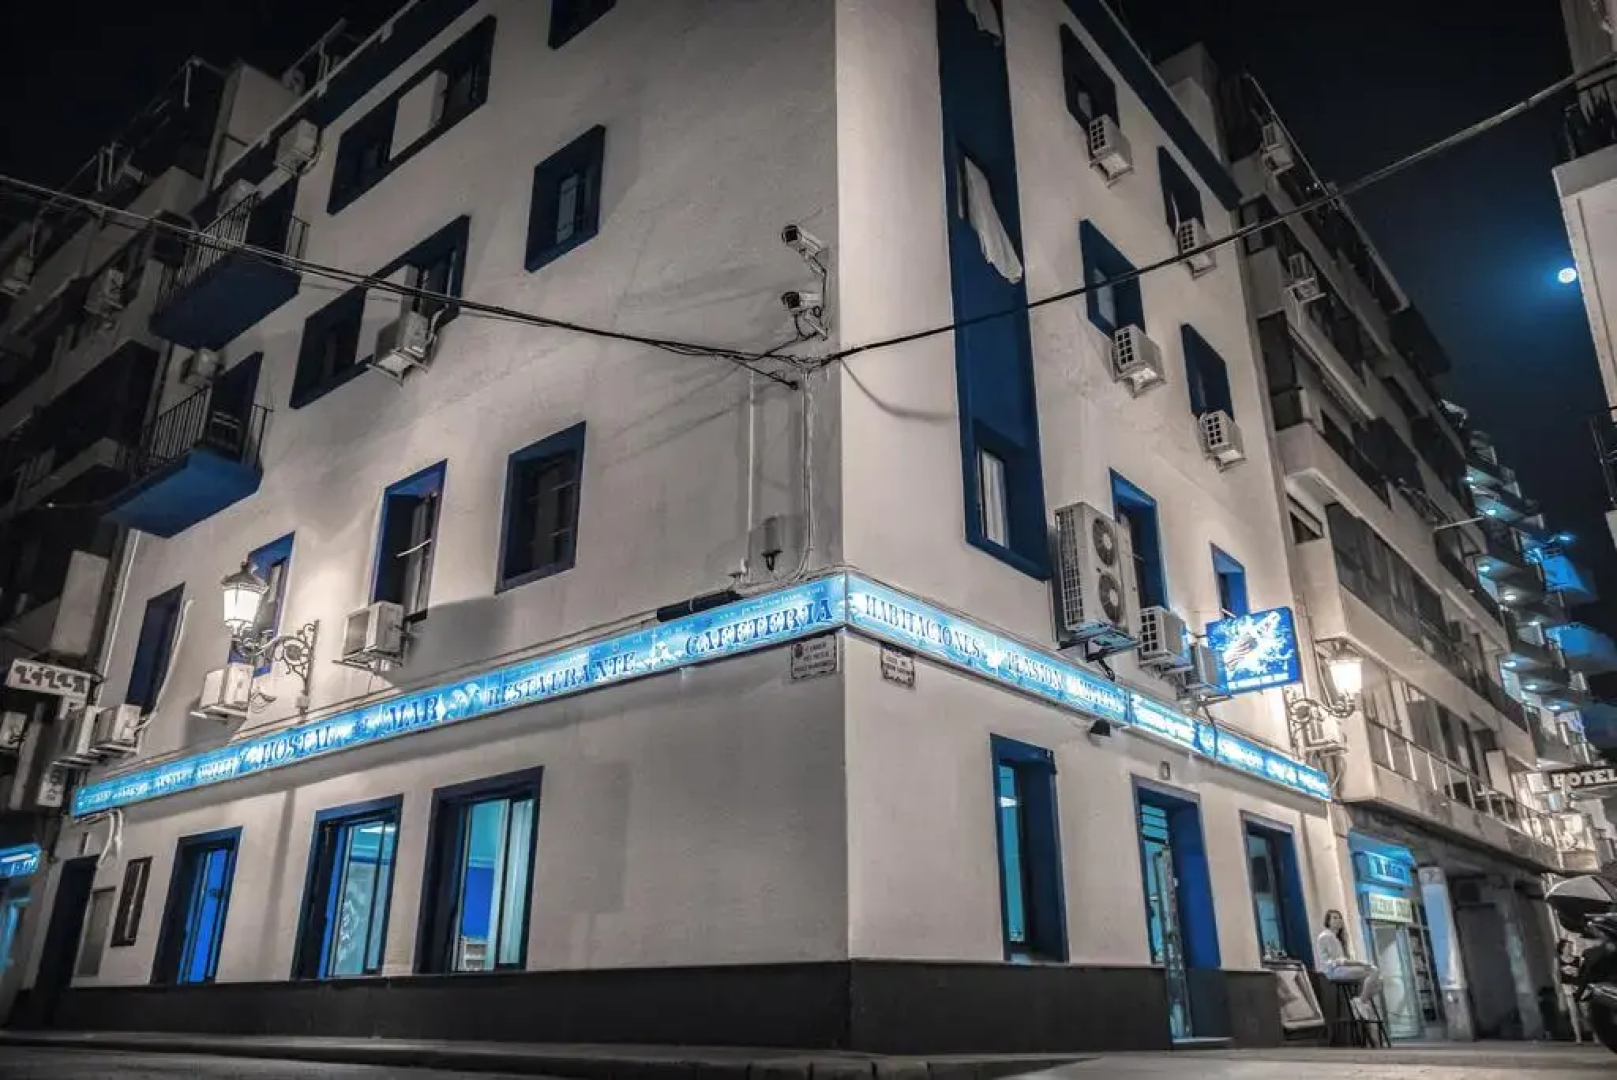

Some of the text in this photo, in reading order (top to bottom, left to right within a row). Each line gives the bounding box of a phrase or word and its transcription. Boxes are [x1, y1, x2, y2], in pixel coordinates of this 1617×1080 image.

[488, 651, 636, 706] RESTAURANTE
[685, 599, 833, 656] CAFETERIA
[864, 594, 980, 658] HABITACIONES
[1552, 768, 1617, 788] HOTEL
